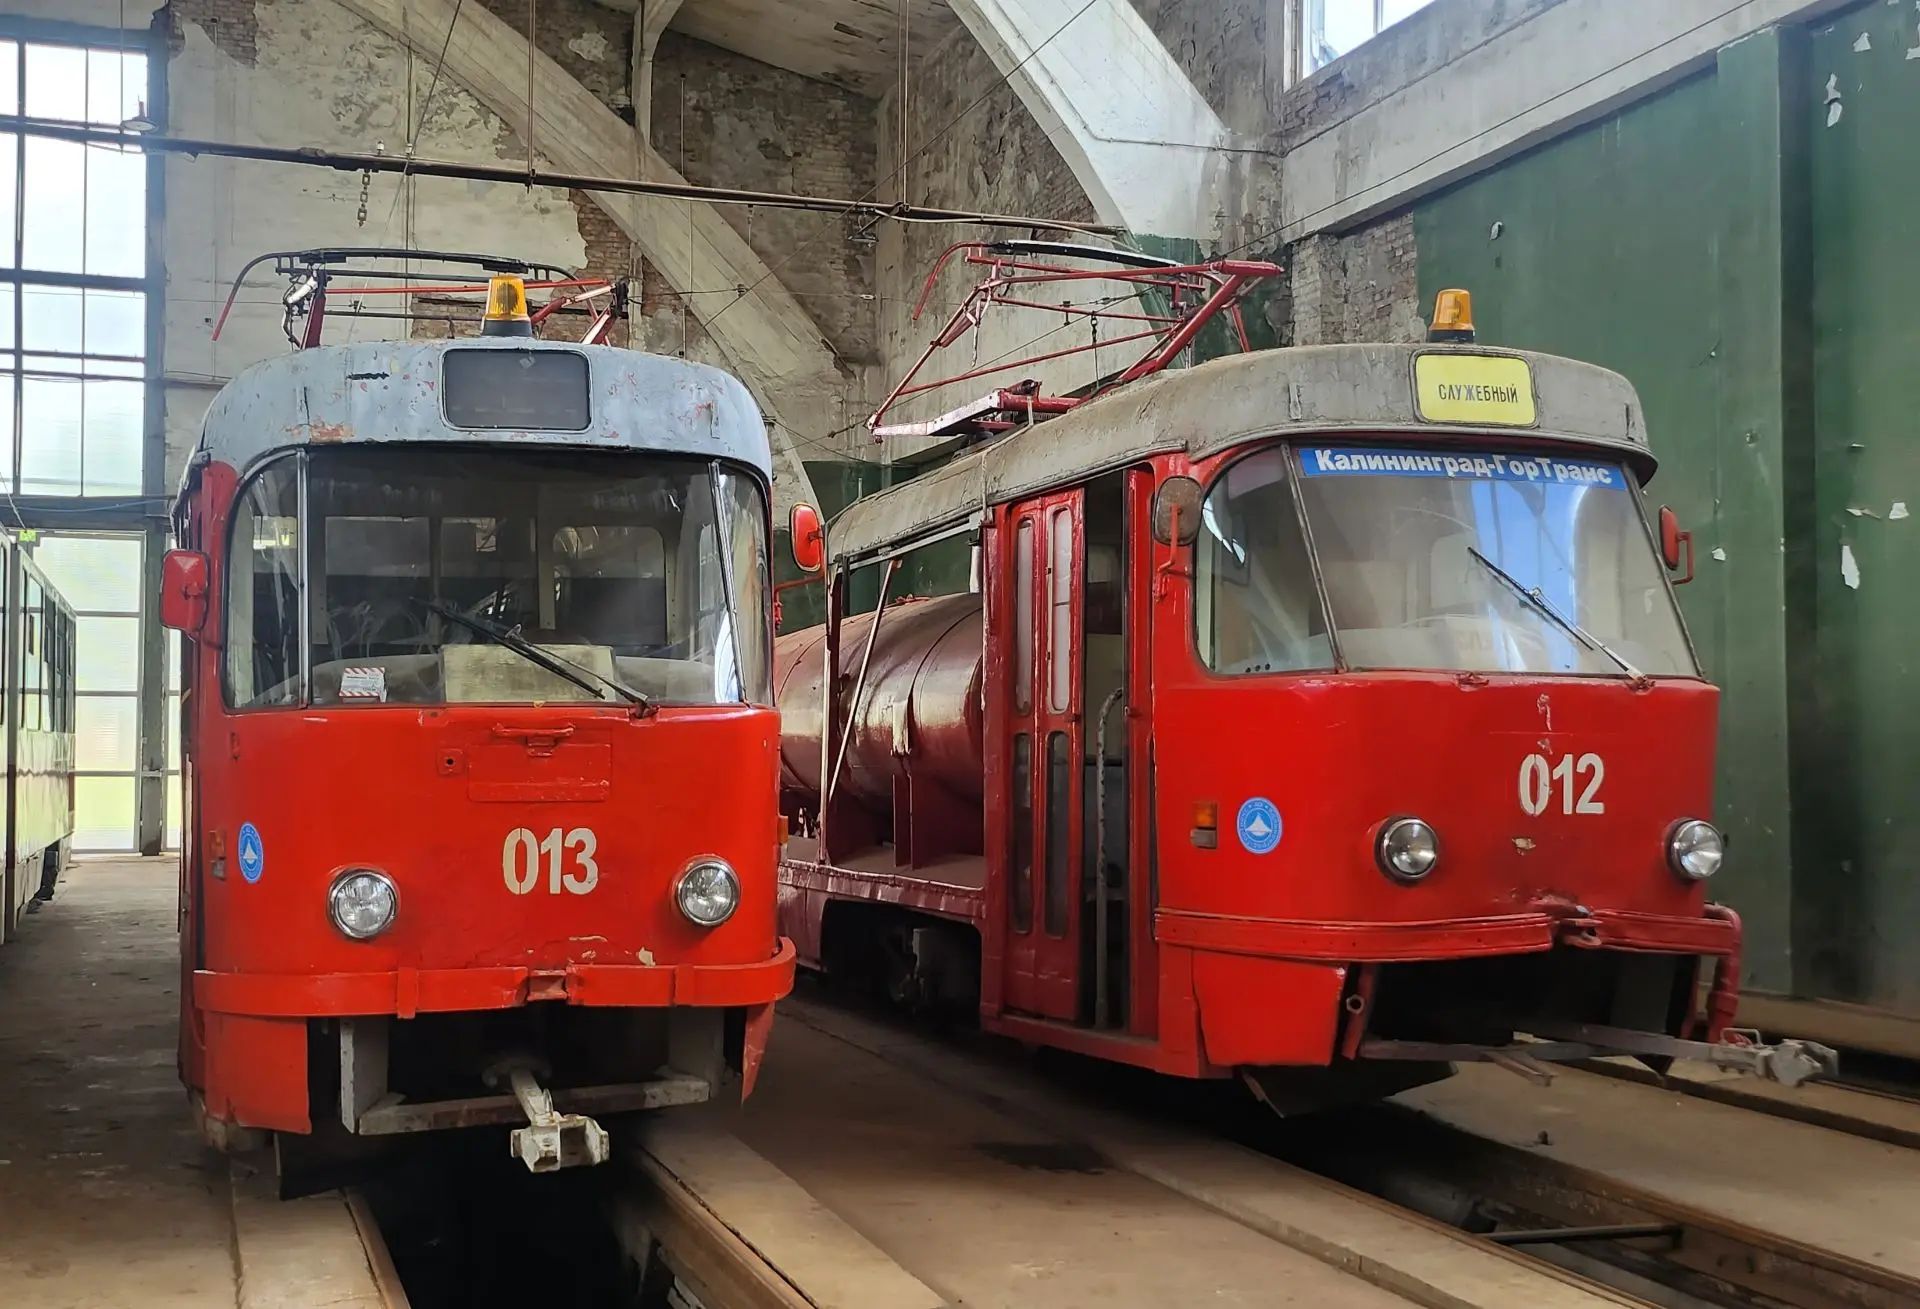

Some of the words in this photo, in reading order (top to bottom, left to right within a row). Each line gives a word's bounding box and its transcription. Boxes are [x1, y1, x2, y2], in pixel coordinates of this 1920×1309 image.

[1438, 383, 1518, 403] СЛУЖЕБНЫЙ
[1315, 449, 1612, 485] Калининград-ГорТранс
[1519, 752, 1605, 816] 012
[502, 827, 599, 895] 013
